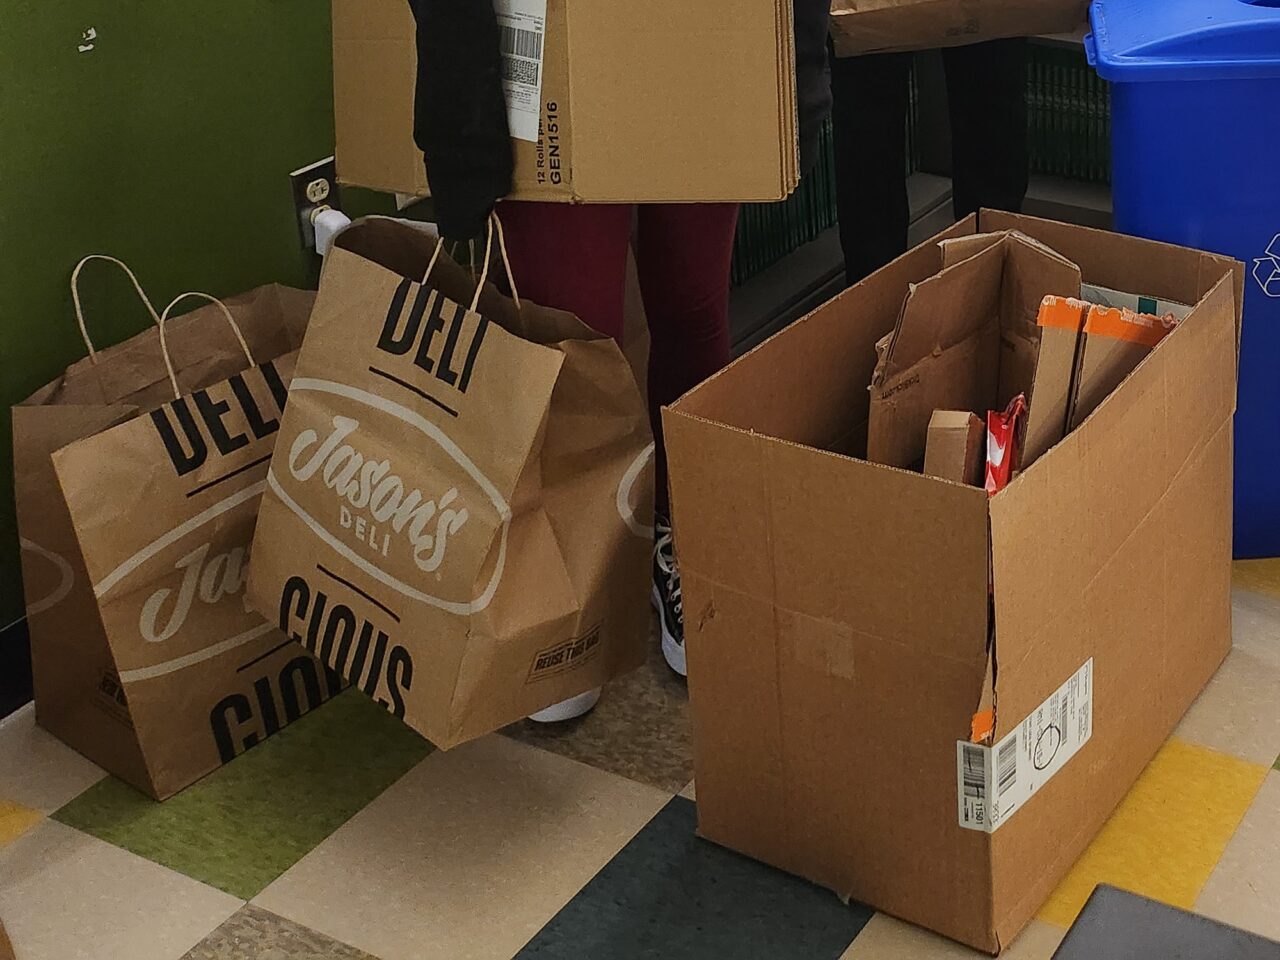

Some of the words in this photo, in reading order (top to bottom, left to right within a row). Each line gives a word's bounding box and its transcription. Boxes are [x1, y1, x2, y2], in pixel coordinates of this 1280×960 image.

[536, 141, 545, 168] Rolls
[537, 171, 546, 184] 12
[546, 102, 561, 185] GEN1516
[377, 276, 489, 393] DELI
[149, 359, 289, 477] DELI
[288, 415, 468, 572] Jason's
[339, 509, 392, 557] DELI
[139, 540, 247, 642] Ja
[279, 575, 412, 722] CIOUS
[210, 656, 341, 765] CIO
